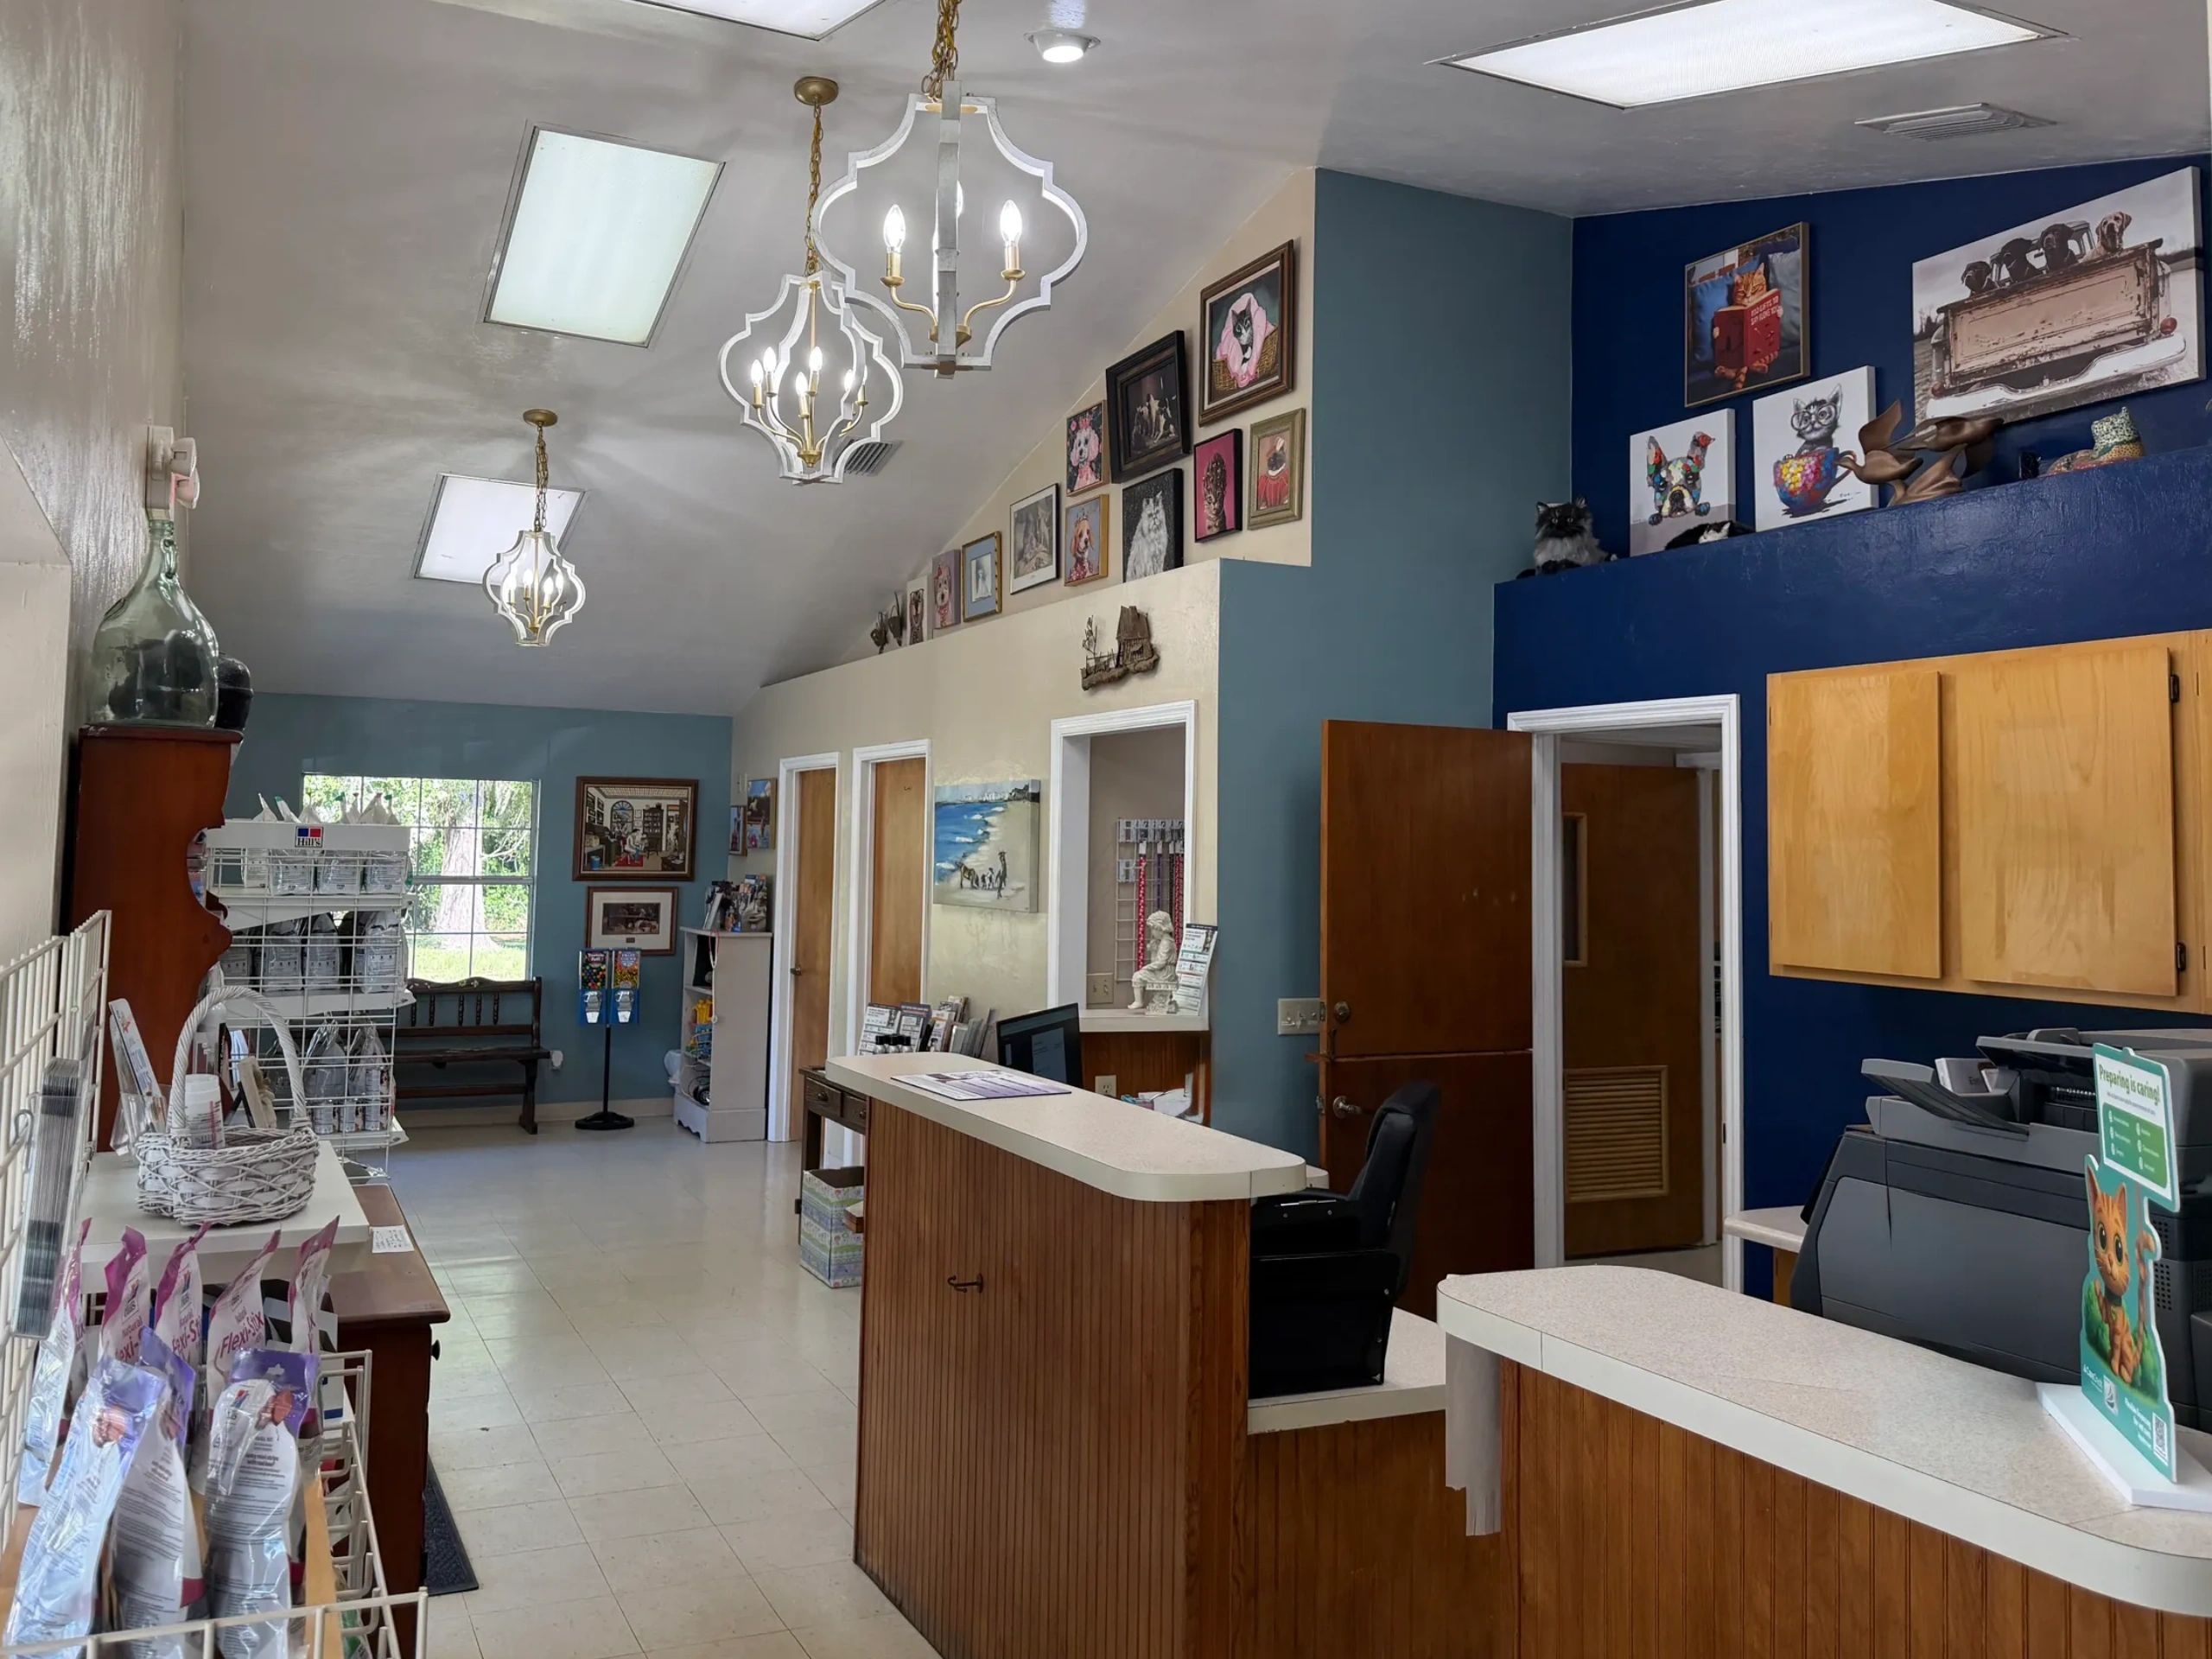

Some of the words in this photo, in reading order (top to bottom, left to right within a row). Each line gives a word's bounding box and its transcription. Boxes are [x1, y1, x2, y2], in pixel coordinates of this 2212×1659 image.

[2099, 1064, 2130, 1095] Preparing
[2130, 1075, 2137, 1093] is
[2137, 1081, 2161, 1106] caring!
[219, 1312, 264, 1358] Flexi-Stix
